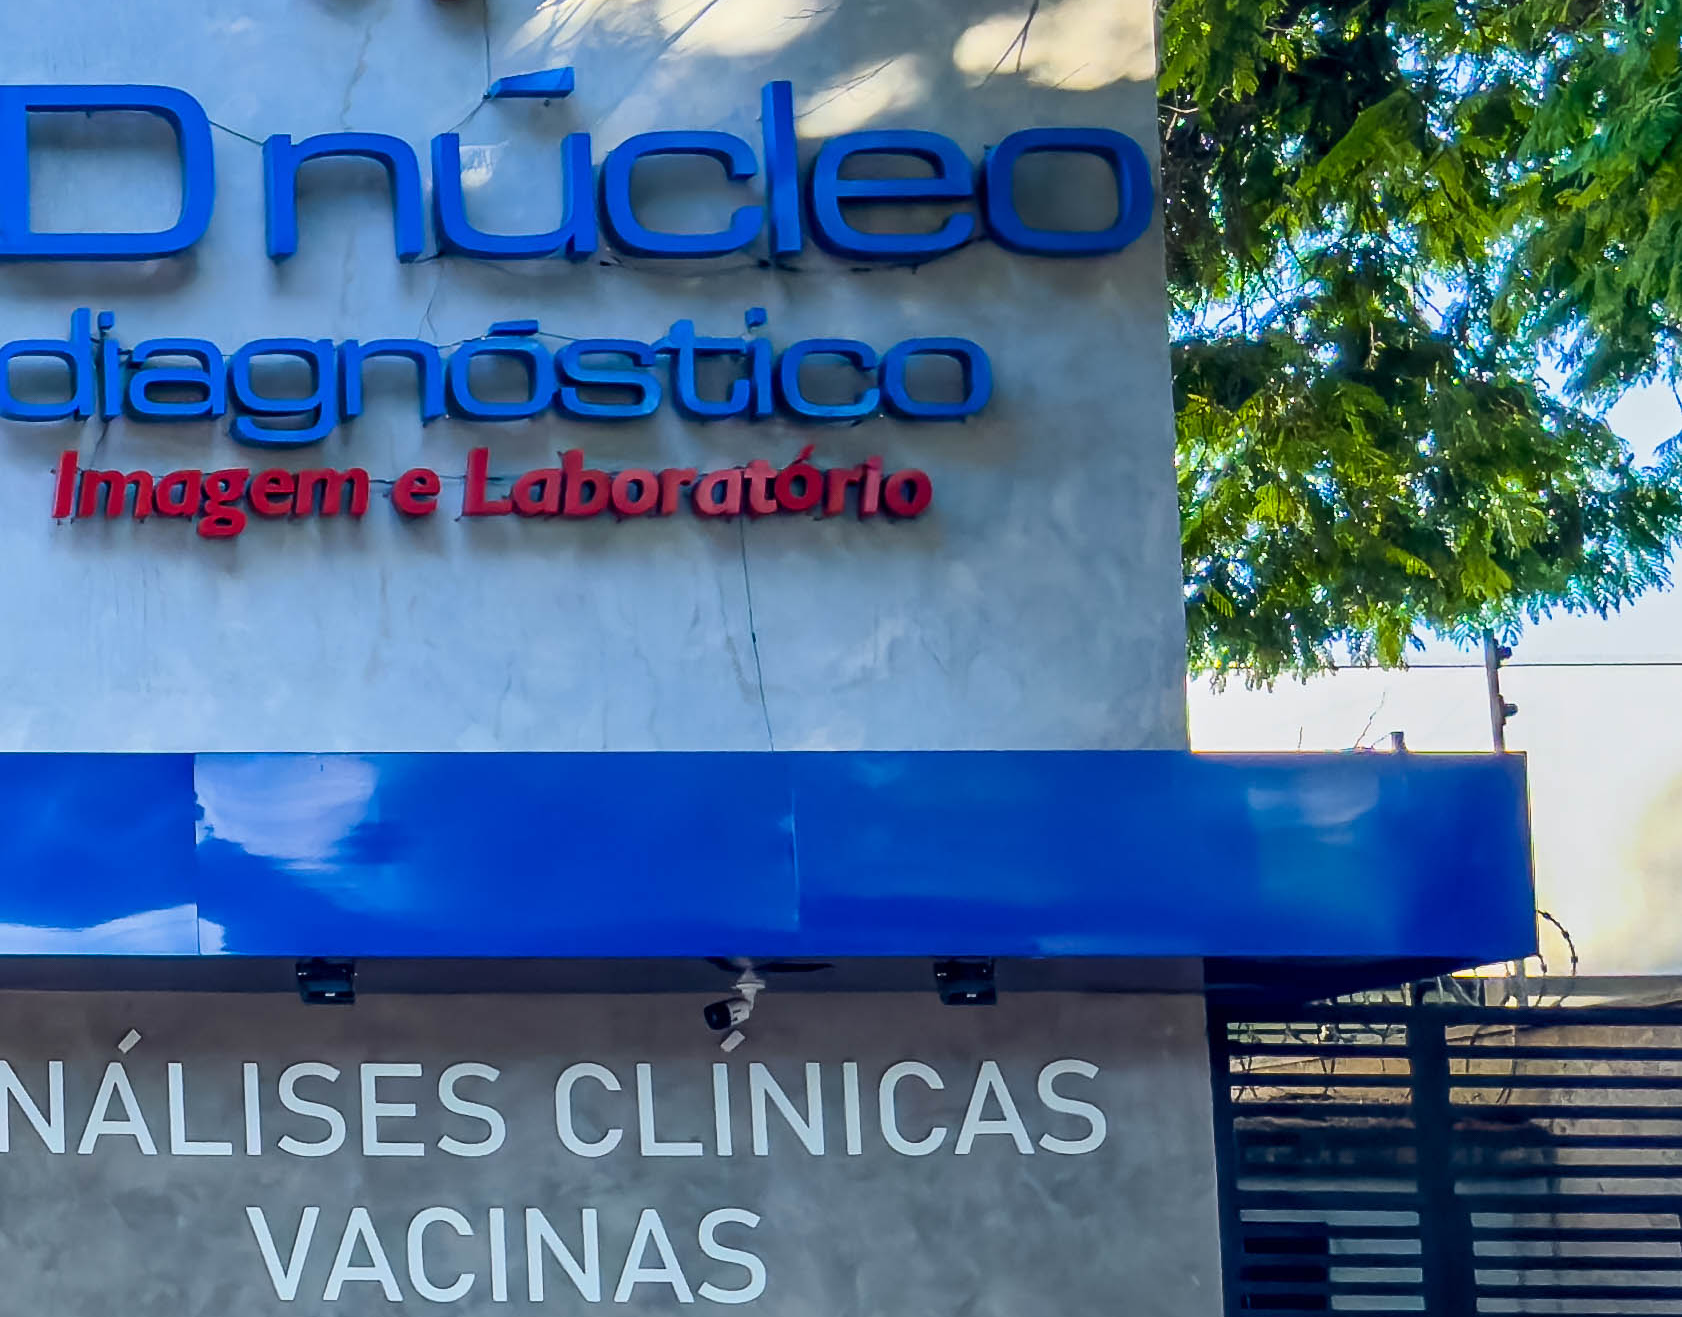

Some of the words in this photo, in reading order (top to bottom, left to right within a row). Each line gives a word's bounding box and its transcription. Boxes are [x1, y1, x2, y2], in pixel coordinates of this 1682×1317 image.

[262, 65, 1154, 263] núcleo
[54, 449, 371, 538] Imagem
[389, 469, 440, 521] e
[462, 444, 934, 522] Laboratório
[554, 1029, 1111, 1158] CLÍNICAS
[247, 1205, 767, 1304] VACINAS
